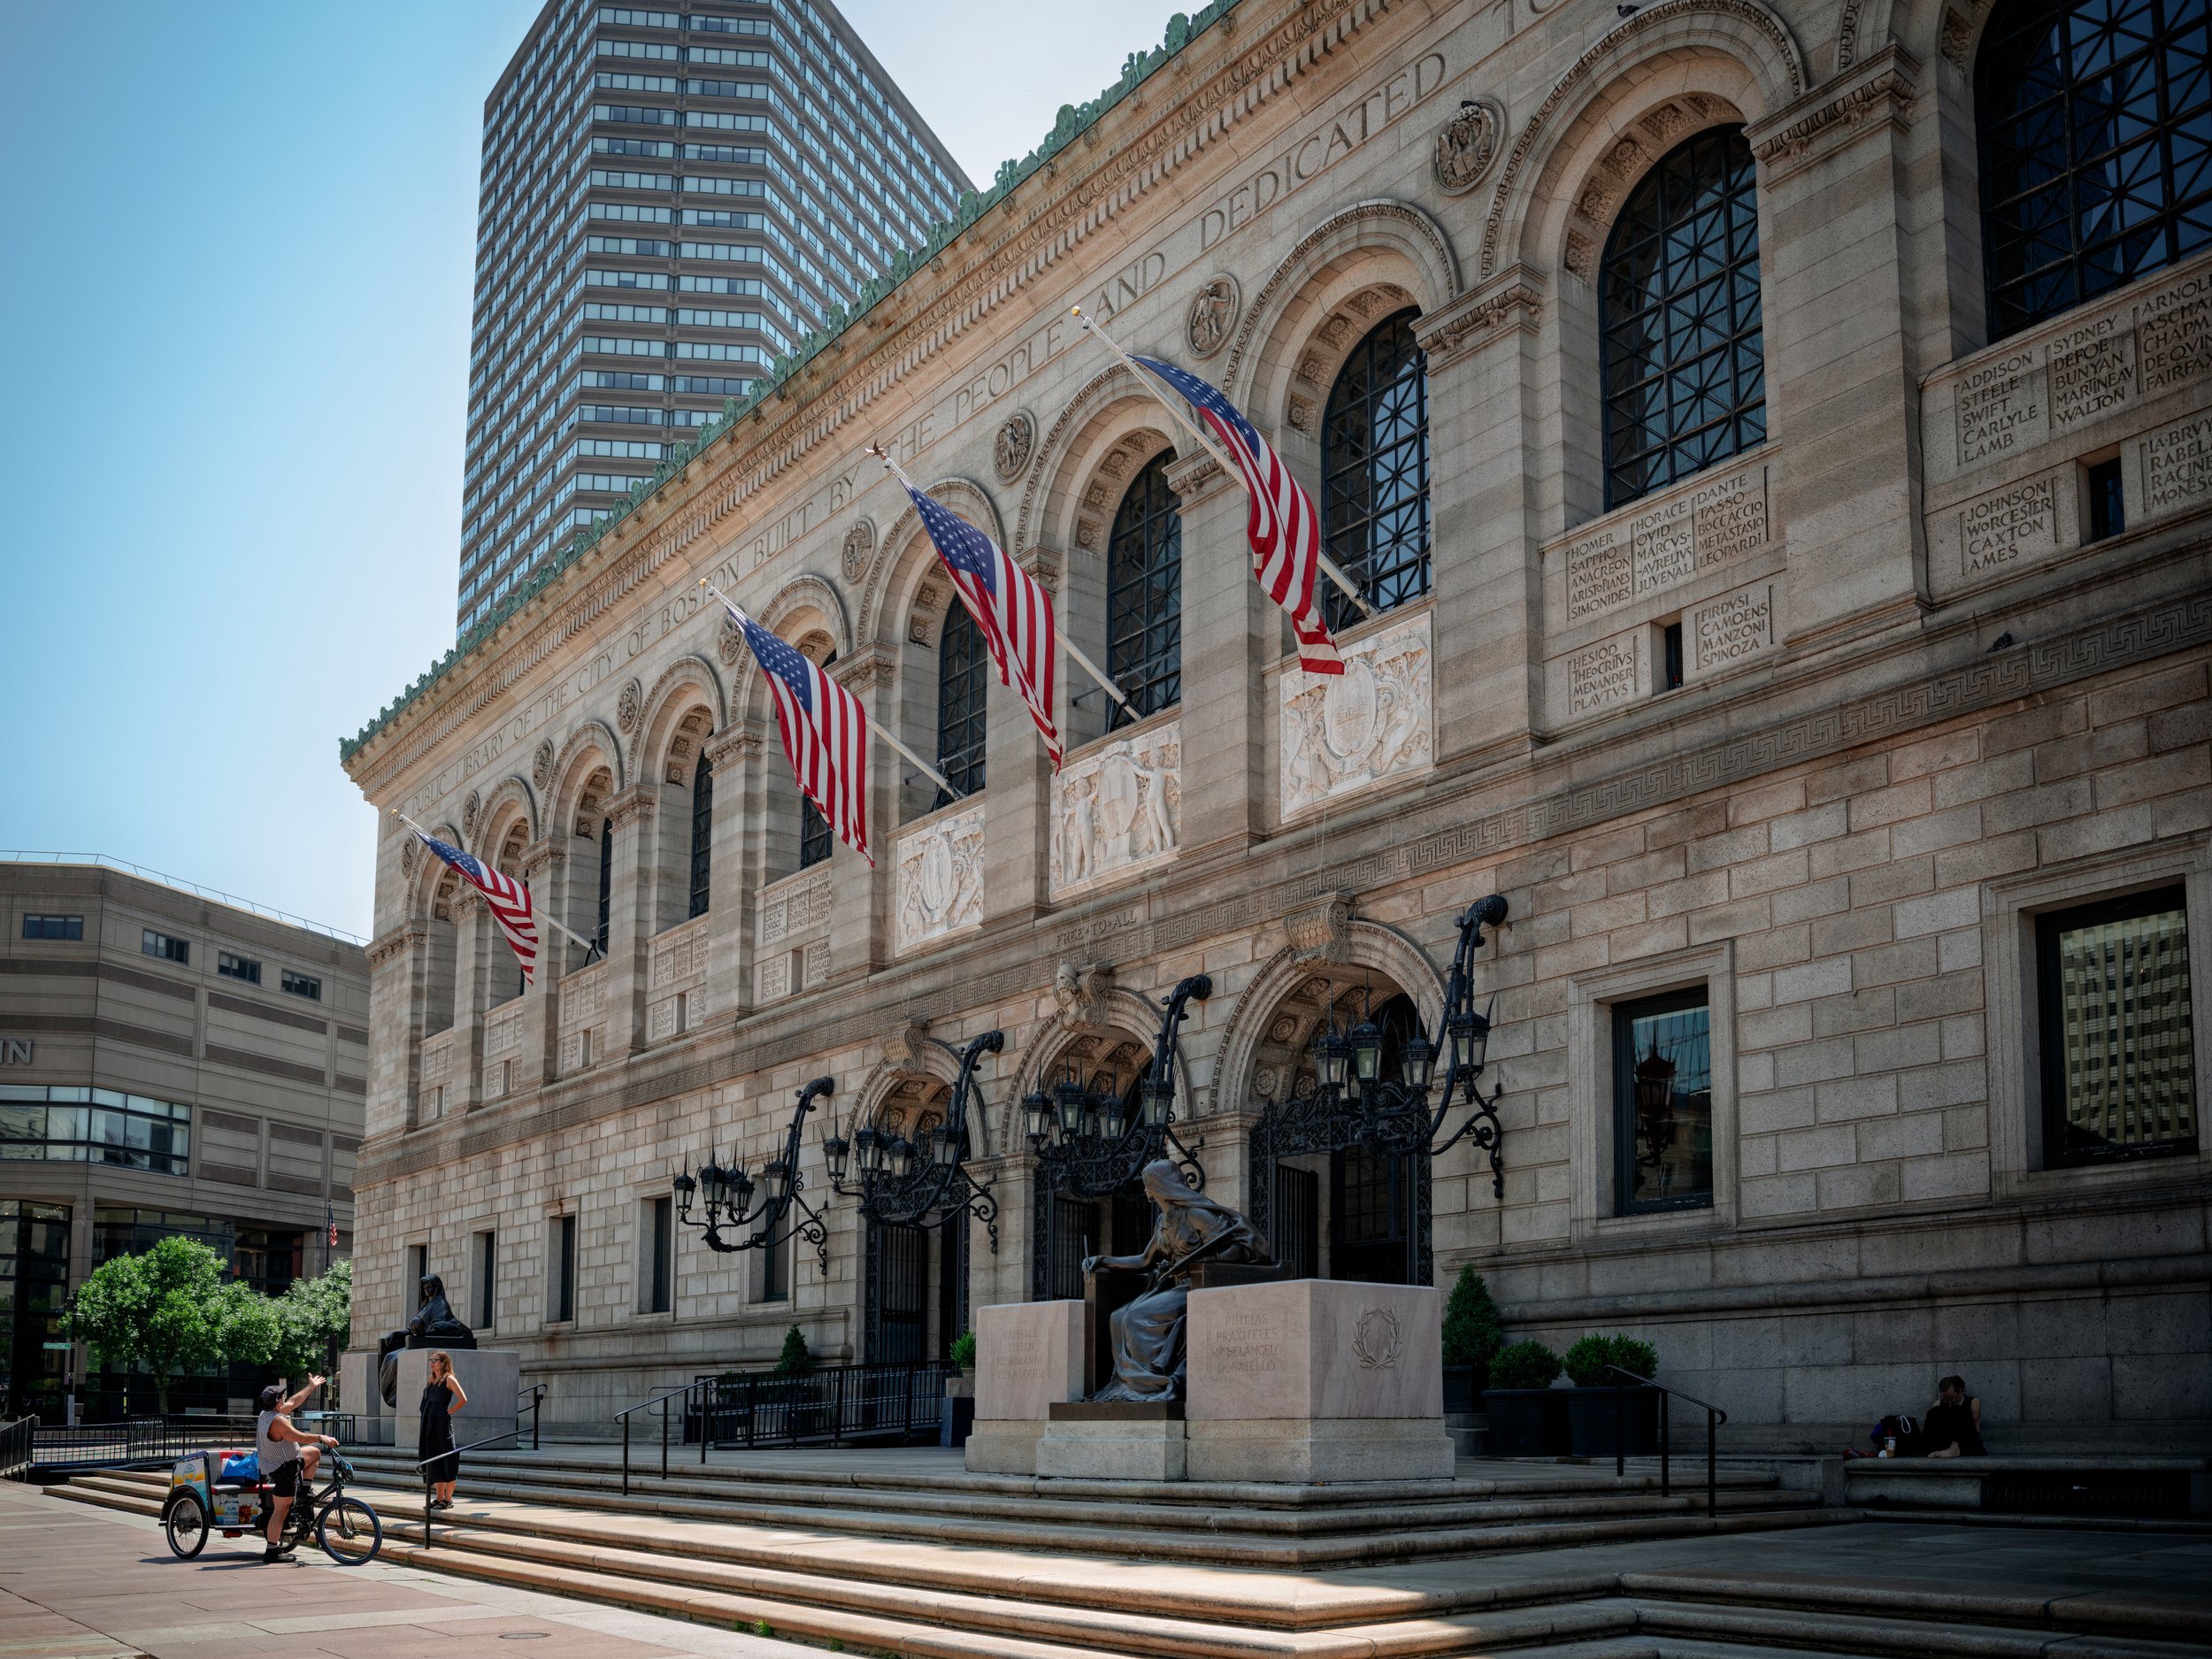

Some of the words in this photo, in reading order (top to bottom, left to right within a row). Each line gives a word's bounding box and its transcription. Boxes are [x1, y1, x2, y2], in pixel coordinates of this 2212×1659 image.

[2143, 298, 2212, 334] ASCHA
[2053, 314, 2119, 355] SYDNEY
[2054, 339, 2110, 373] DEFOE
[2055, 350, 2124, 392] BUNYAN
[1960, 351, 2032, 394] ADDISON
[1961, 375, 2020, 411] STEELE
[2055, 388, 2125, 426] WALTON
[1962, 398, 2011, 429] SWIFT
[1962, 404, 2038, 446] CARLYLE
[412, 774, 447, 817] PUBLIC
[455, 727, 506, 785] LIBRARY
[513, 710, 532, 741] OF
[542, 686, 568, 718] THE
[577, 648, 617, 695] CITY
[627, 626, 650, 657] OF
[660, 562, 740, 635] BOSTON
[753, 502, 814, 568] BUILT
[829, 465, 860, 515] BY
[954, 320, 1065, 426] PEOPLE
[1094, 251, 1166, 321] AND
[1200, 52, 1447, 253] DEDICATED
[1963, 434, 2014, 464] LAMB
[2150, 441, 2212, 472] RABEL
[1697, 474, 1747, 504] DANTE
[1698, 491, 1745, 519] TASSO
[1966, 480, 2047, 523] JOHNSON
[1636, 501, 1686, 532] HORACE
[1571, 533, 1614, 558] HOMER
[1637, 524, 1671, 546] OVID
[1699, 517, 1764, 552] METASTASIO
[1699, 533, 1762, 567] LEOPARDI
[1969, 517, 2044, 556] CAXTON
[1571, 546, 1617, 574] SAPPHO
[1571, 556, 1631, 589] ANACREON
[1970, 544, 2018, 573] AMES
[1571, 587, 1631, 619] SIMONIDES
[1701, 603, 1769, 637] CAMOENS
[1701, 620, 1766, 653] MANZONI
[1572, 644, 1618, 670] HESIOD
[1702, 638, 1761, 668] SPINOZA
[1573, 668, 1634, 697] MENANDER
[1056, 926, 1085, 948] FREE
[1090, 919, 1106, 936] TO
[1112, 910, 1137, 929] ALL
[1217, 1329, 1278, 1342] PRAXITELES
[1225, 1313, 1268, 1326] PHIDIAS
[1211, 1344, 1283, 1359] MICHELANGELO
[1218, 1360, 1276, 1373] DONATELLO
